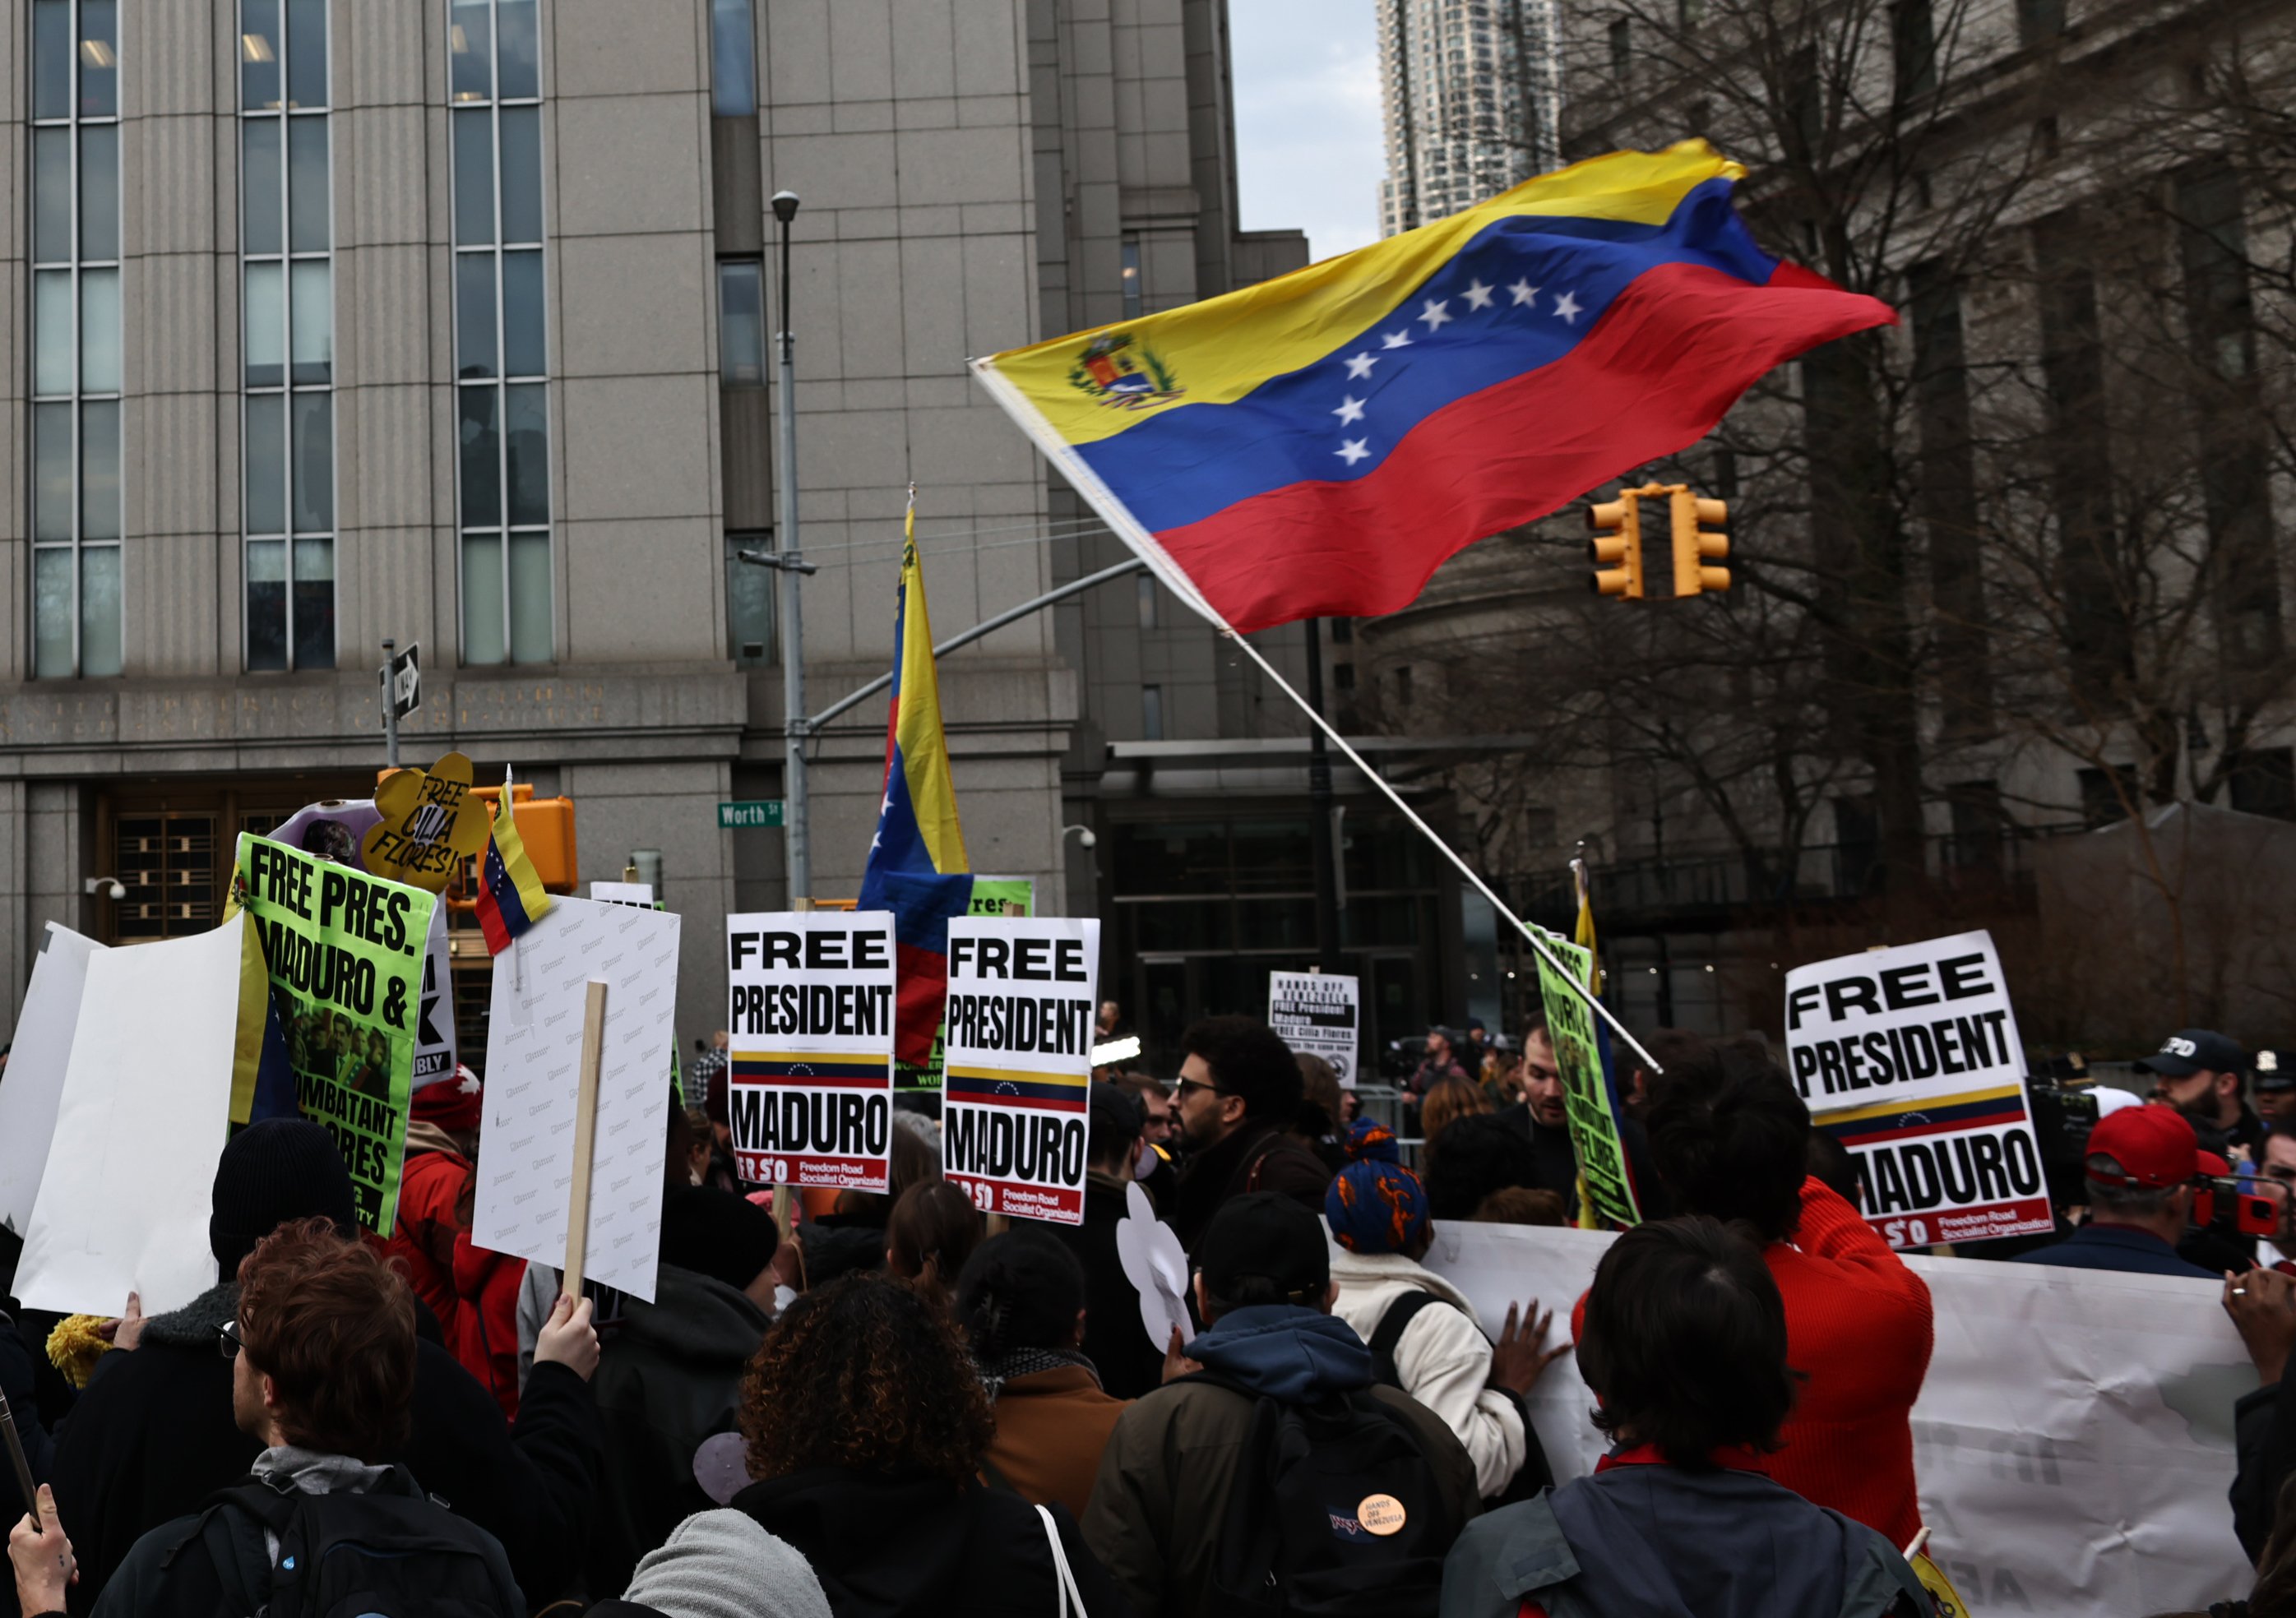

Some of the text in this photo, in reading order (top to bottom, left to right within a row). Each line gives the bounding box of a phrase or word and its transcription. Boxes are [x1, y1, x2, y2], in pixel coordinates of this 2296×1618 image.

[417, 774, 470, 807] FREE
[400, 805, 458, 844] CILIA
[722, 805, 765, 825] Worth
[369, 830, 459, 877] FLORES!
[251, 842, 415, 957] FREE PRES.
[731, 930, 889, 970] FREE
[950, 937, 1088, 982] FREE
[252, 913, 376, 1016] MADURO
[382, 975, 408, 1031] &
[1277, 979, 1344, 992] HANDS OFF
[1789, 952, 1995, 1031] FREE
[732, 984, 893, 1036] PRESIDENT
[1274, 1001, 1296, 1013] FREE
[1283, 991, 1349, 1004] VENEZUELA
[947, 994, 1092, 1056] PRESIDENT
[1792, 1009, 2011, 1098] PRESIDENT
[294, 1070, 397, 1140] OMBATANT
[731, 1089, 888, 1156] MADURO
[946, 1107, 1086, 1186] MADURO
[799, 1162, 863, 1175] Freedom Road
[799, 1172, 886, 1188] Socialist Organization
[1002, 1188, 1059, 1206] Freedom Road
[1002, 1201, 1036, 1215] Socialist
[1937, 1209, 2016, 1227] Freedom Road
[1941, 1226, 1988, 1240] Socialist
[1365, 1500, 1390, 1510] HANDS
